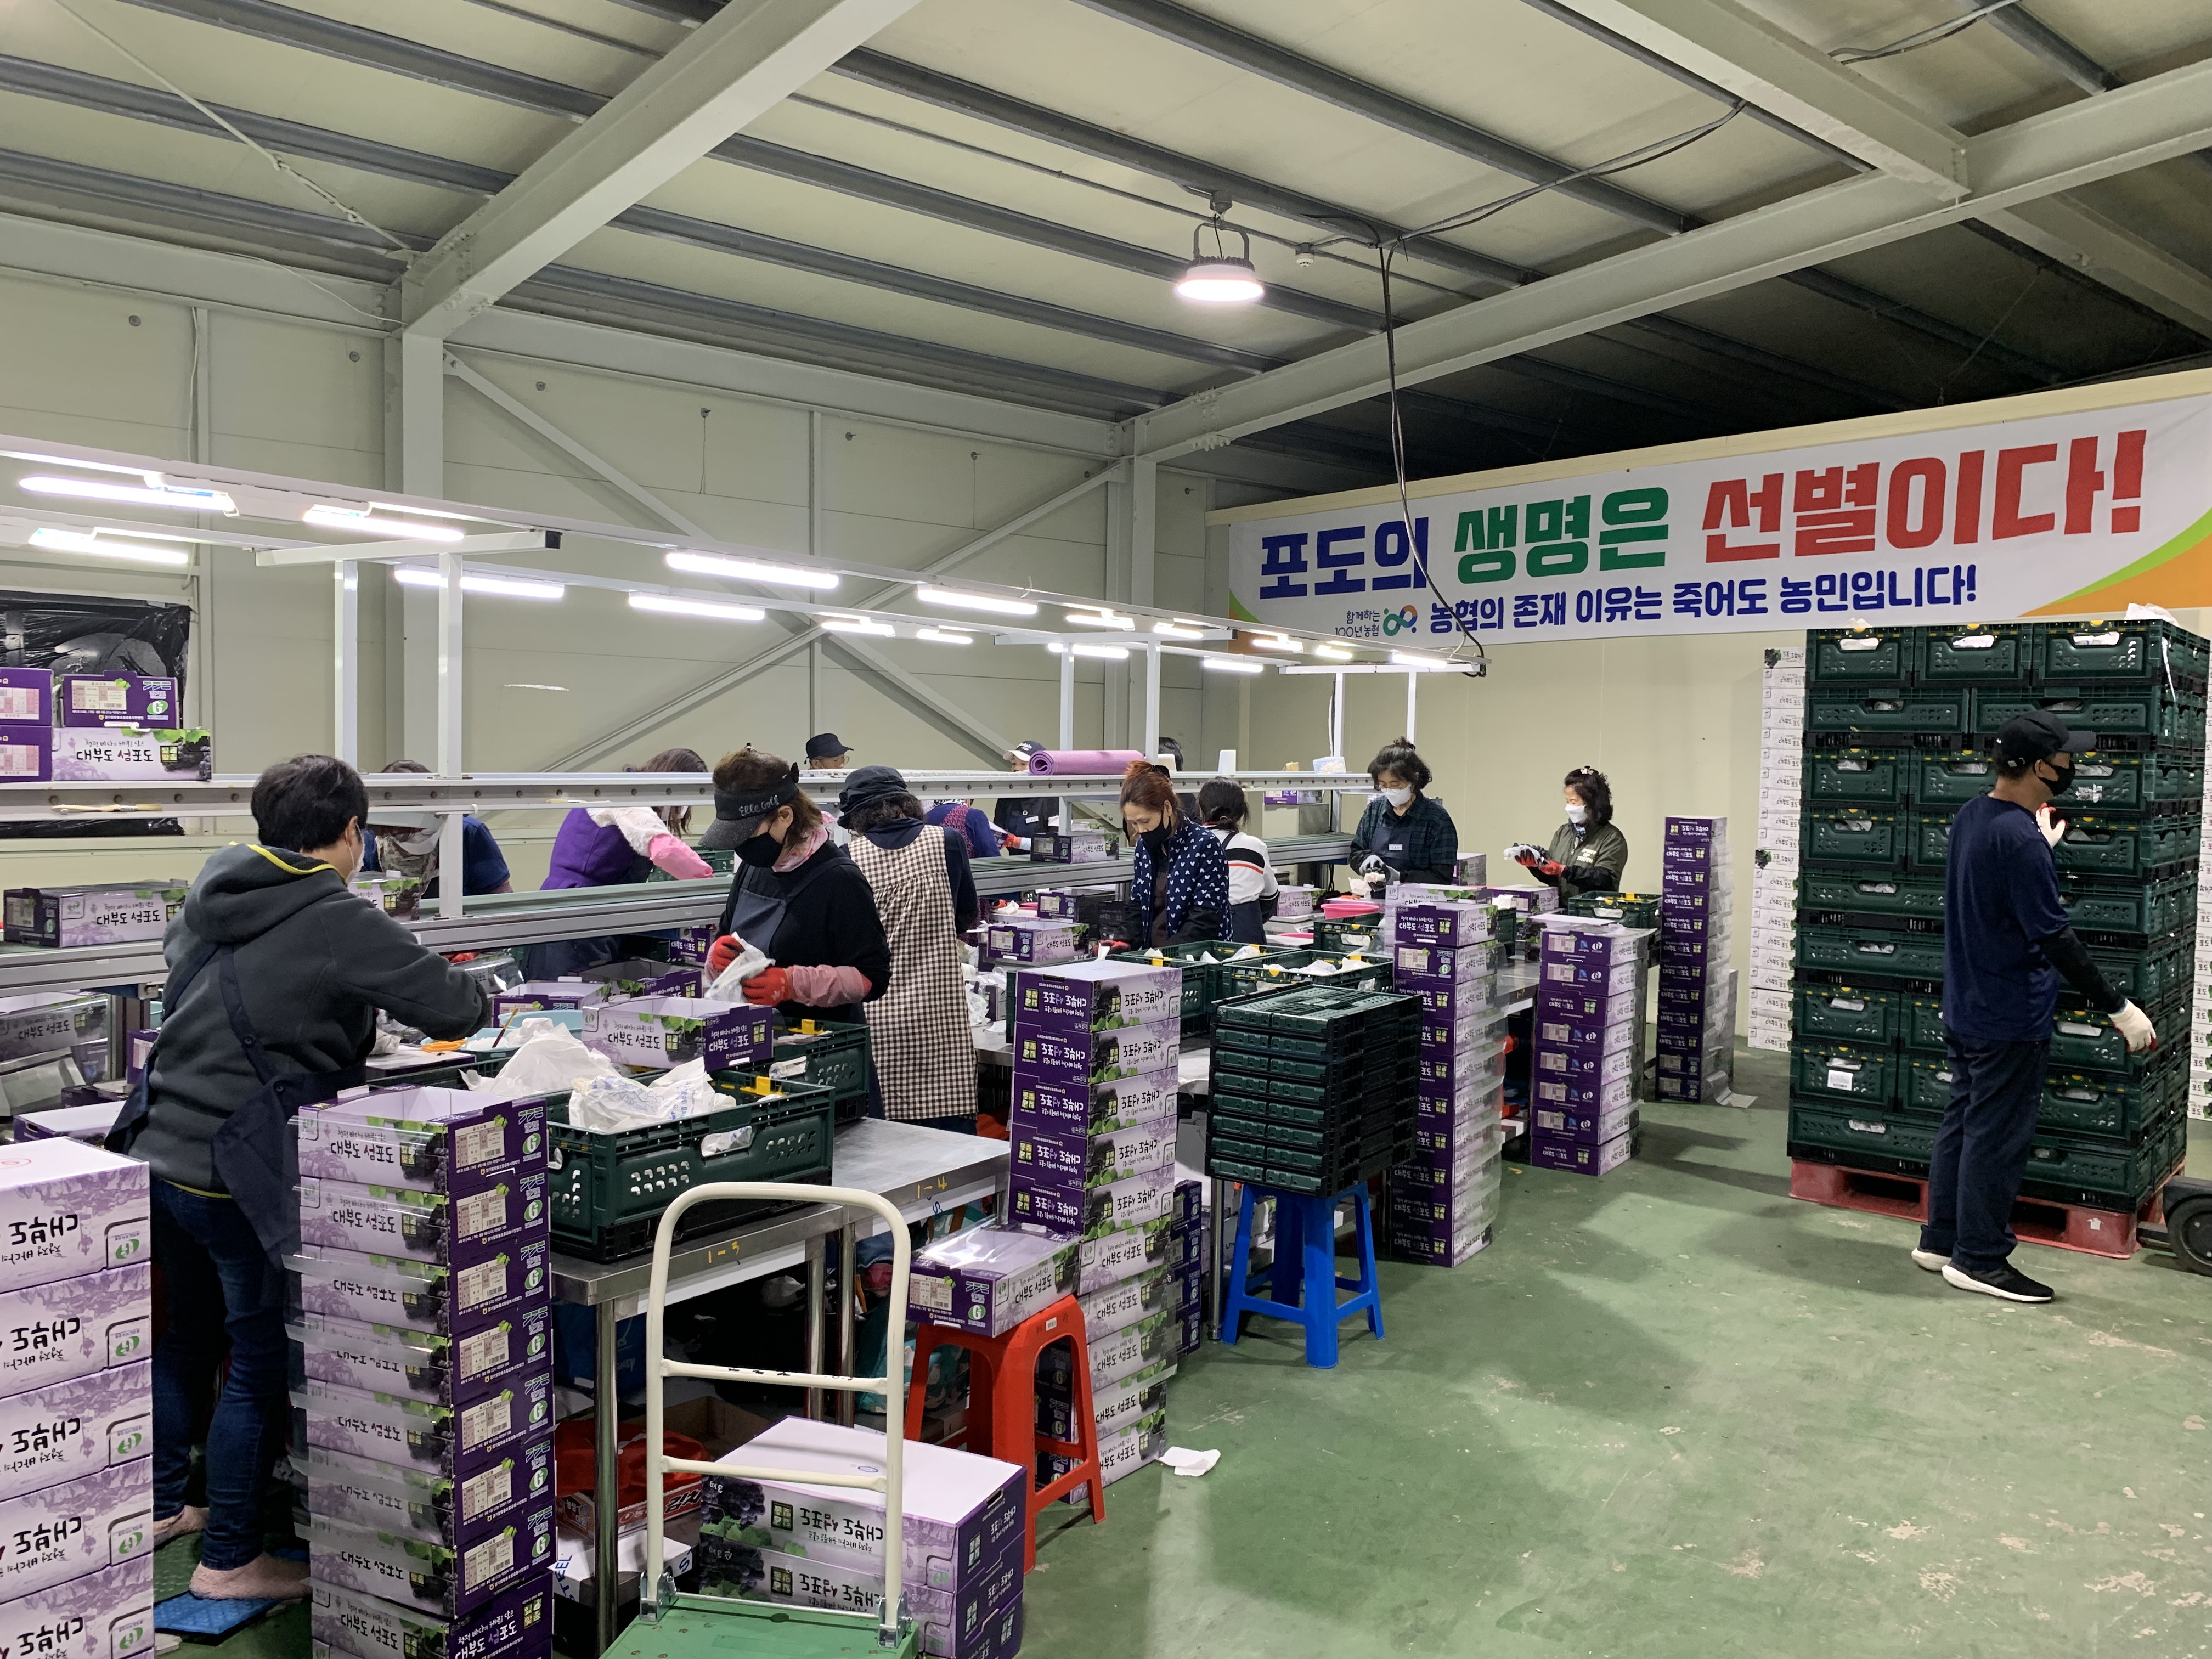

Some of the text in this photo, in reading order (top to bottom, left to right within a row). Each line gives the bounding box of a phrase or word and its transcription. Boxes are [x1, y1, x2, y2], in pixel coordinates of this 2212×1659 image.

[1260, 430, 2147, 599] 포도의 생명은 선별이다!
[1430, 565, 1977, 634] 농협의 존재 이유는 죽어도 농민입니다!
[1346, 609, 1380, 624] 함께하는
[76, 749, 153, 763] 대부도 섬포도
[738, 795, 780, 817] Elle Golf
[97, 910, 161, 926] 대부도 섬포도
[1399, 922, 1435, 933] 대부도 섬포도
[1047, 938, 1071, 949] 대부도 섬포도
[1043, 991, 1086, 1008] 대부도 섬포도
[1124, 990, 1163, 1008] 대부도 섬포도
[19, 1019, 71, 1039] 대부도 섬포도
[608, 1031, 661, 1049] 대부도 섬포도
[709, 1034, 749, 1052] 대부도 섬포도
[1122, 1040, 1161, 1058] 대부도 섬포도
[1041, 1043, 1085, 1060] 대부도 섬포도
[1040, 1093, 1084, 1111] 대부도 섬포도
[1121, 1090, 1159, 1108] 대부도 섬포도
[331, 1139, 394, 1163] 대부도 섬포도
[1037, 1146, 1081, 1164] 대부도 섬포도
[1119, 1139, 1157, 1159] 대부도 섬포도
[917, 1176, 947, 1199] 1-4
[1035, 1196, 1079, 1216] 대부도 섬포도
[1117, 1189, 1155, 1211] 대부도 섬포도
[8, 1214, 78, 1245] 대부도
[333, 1209, 396, 1233] 대부도 섬포도
[37, 1244, 60, 1259] 청정
[1102, 1244, 1142, 1267] 대부도 섬포도
[1015, 1274, 1052, 1304] 대부도 섬포도
[1097, 1296, 1138, 1319] 대부도 섬포도
[10, 1318, 80, 1352] 대부도
[39, 1348, 63, 1362] 청정
[1097, 1346, 1138, 1372] 대부도 섬포도
[1095, 1395, 1136, 1423] 대부도 섬포도
[11, 1418, 80, 1453] 대부도
[40, 1448, 63, 1464] 청정
[1117, 1444, 1136, 1463] 섬포도
[799, 1508, 883, 1542] 대부도 섬포도
[13, 1517, 81, 1555] 대부도
[42, 1548, 65, 1564] 청정
[799, 1573, 881, 1607] 대부도 섬포도
[341, 1613, 398, 1650] 대부도 섬포도
[455, 1620, 517, 1659] 대부도 섬포도
